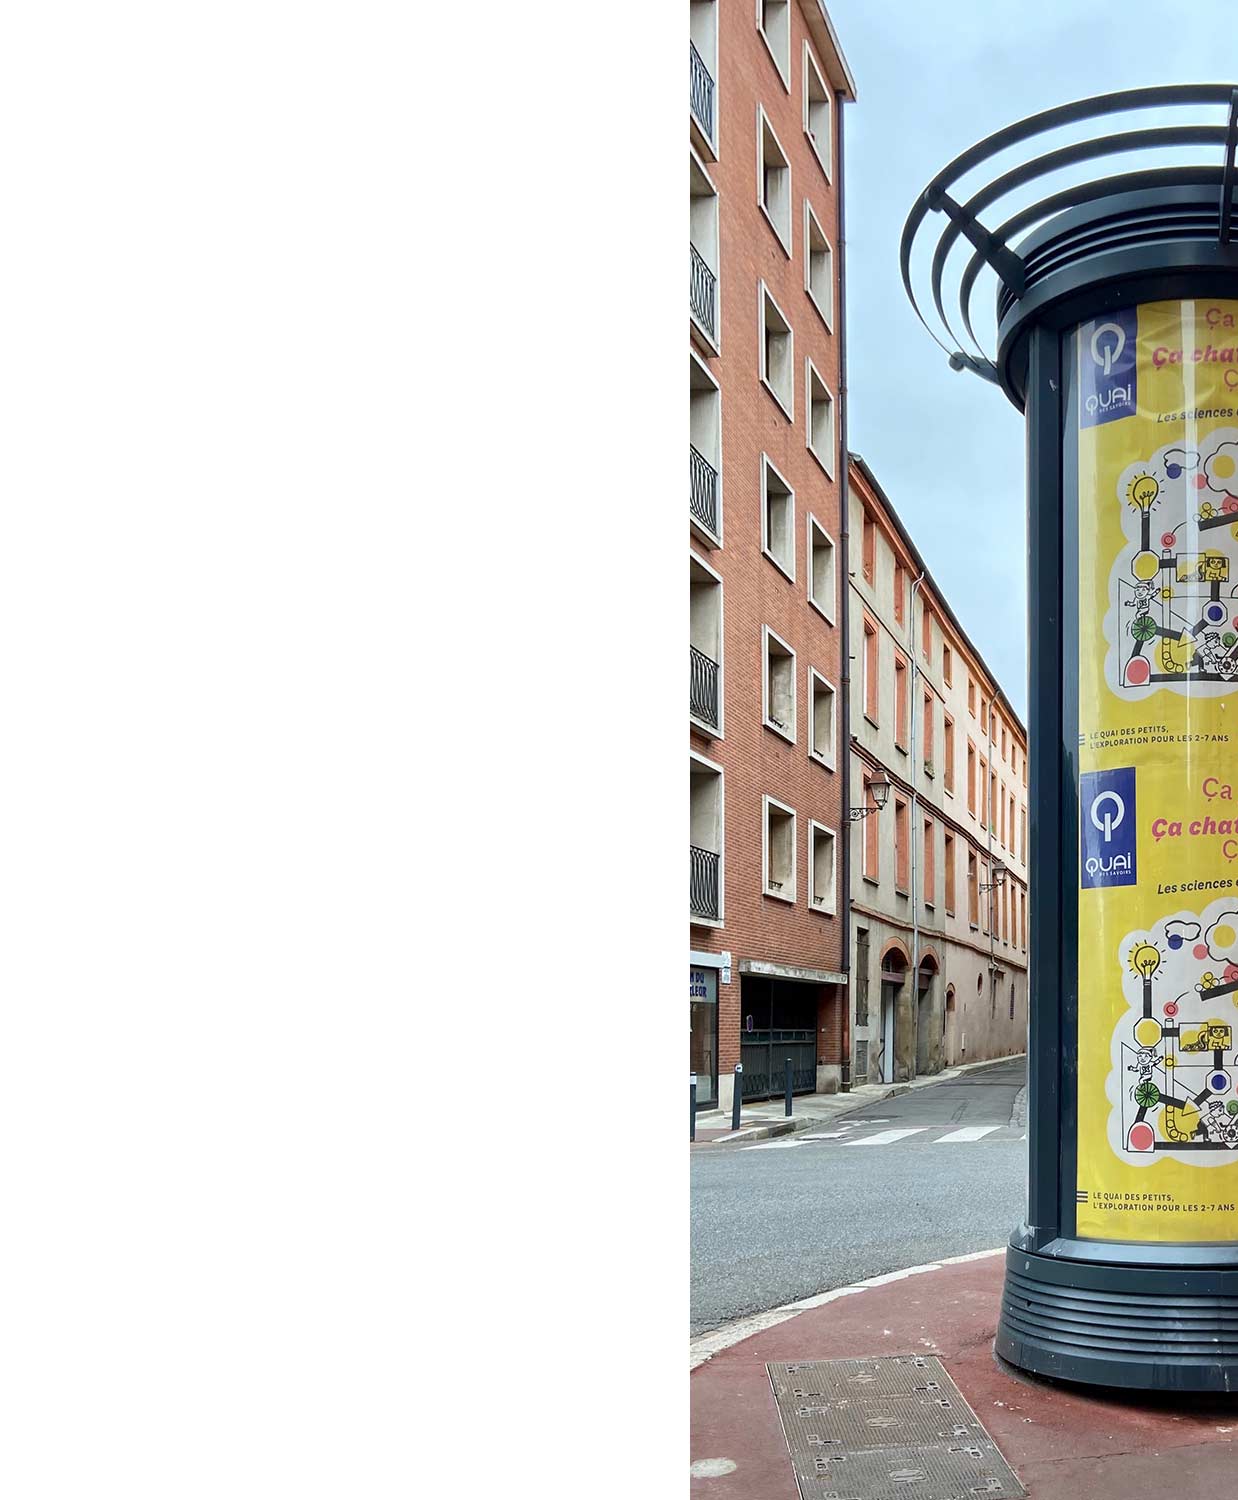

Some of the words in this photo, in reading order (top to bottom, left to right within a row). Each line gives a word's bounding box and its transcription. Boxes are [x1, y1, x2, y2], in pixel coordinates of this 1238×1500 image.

[1206, 308, 1234, 330] Ça
[1152, 346, 1182, 370] Ça
[1157, 412, 1177, 424] Les
[1180, 407, 1233, 420] sciences
[1090, 732, 1098, 740] LE
[1100, 730, 1118, 738] QUAI
[1121, 728, 1136, 736] DES
[1177, 734, 1192, 742] LES
[1212, 734, 1229, 742] ANS
[1202, 778, 1232, 802] Ça
[1151, 818, 1182, 842] Ça
[1157, 884, 1177, 894] Les
[1180, 877, 1233, 891] sciences
[1103, 1193, 1122, 1201] QUAI
[1124, 1193, 1140, 1201] DES
[1142, 1193, 1174, 1203] PETITS,
[1093, 1202, 1154, 1211] L'EXPLORATION
[1156, 1204, 1180, 1212] POUR
[1182, 1204, 1198, 1212] LES
[1200, 1204, 1215, 1212] 2-7
